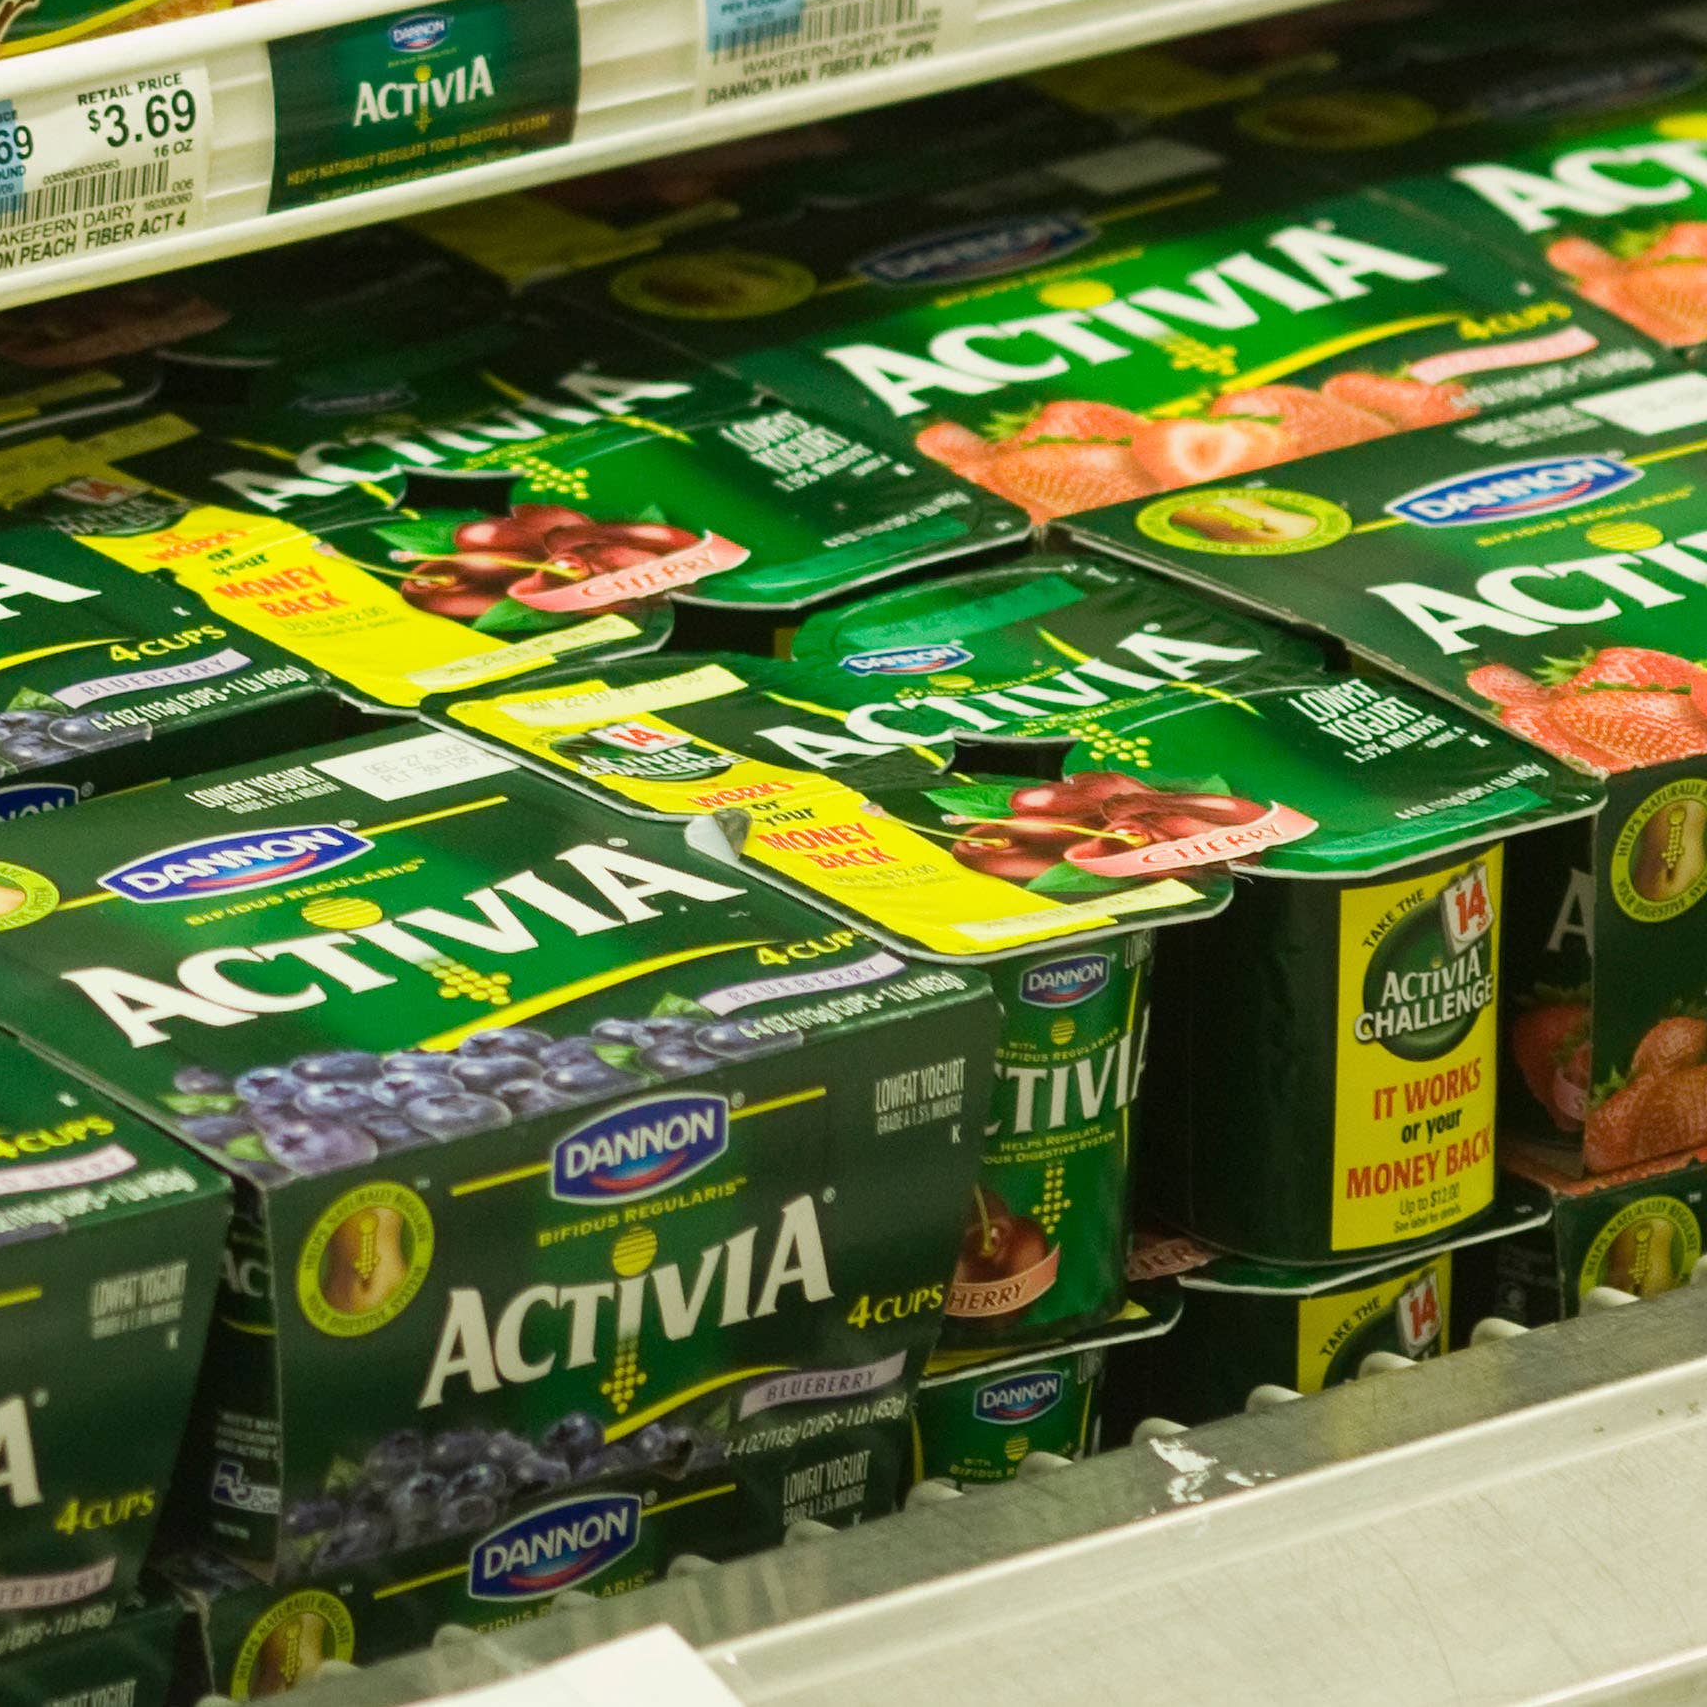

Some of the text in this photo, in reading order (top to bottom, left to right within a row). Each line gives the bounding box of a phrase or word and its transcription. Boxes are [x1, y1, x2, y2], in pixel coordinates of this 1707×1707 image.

[87, 89, 196, 147] $3.69
[353, 55, 495, 127] ACTIVIA
[19, 235, 75, 263] PEACH
[86, 223, 133, 250] FIBER
[138, 216, 171, 236] ACT
[175, 210, 186, 227] 4
[822, 220, 1448, 419] ACTIVIA
[585, 541, 720, 600] CHERRY
[82, 657, 228, 699] BLUEBERRY
[755, 625, 1262, 769] ACTIVIA
[115, 825, 348, 901] DANNON
[758, 822, 878, 852] MONEY
[814, 845, 899, 870] BACK
[1143, 822, 1287, 869] CHERRY
[1362, 888, 1426, 949] TAKE THE
[1455, 881, 1487, 935] 14
[61, 844, 749, 1049] ACTIVIA
[1380, 947, 1482, 1007] ACTIVIA
[1354, 974, 1495, 1041] CHALLENGE
[1374, 1057, 1482, 1121] IT WORKS
[562, 1108, 720, 1178] DANNON
[1401, 1108, 1463, 1144] or your
[1346, 1125, 1492, 1199] MONEY BACK
[417, 1191, 839, 1410] ACTIVIA
[763, 1368, 877, 1407] BLUEBERRY
